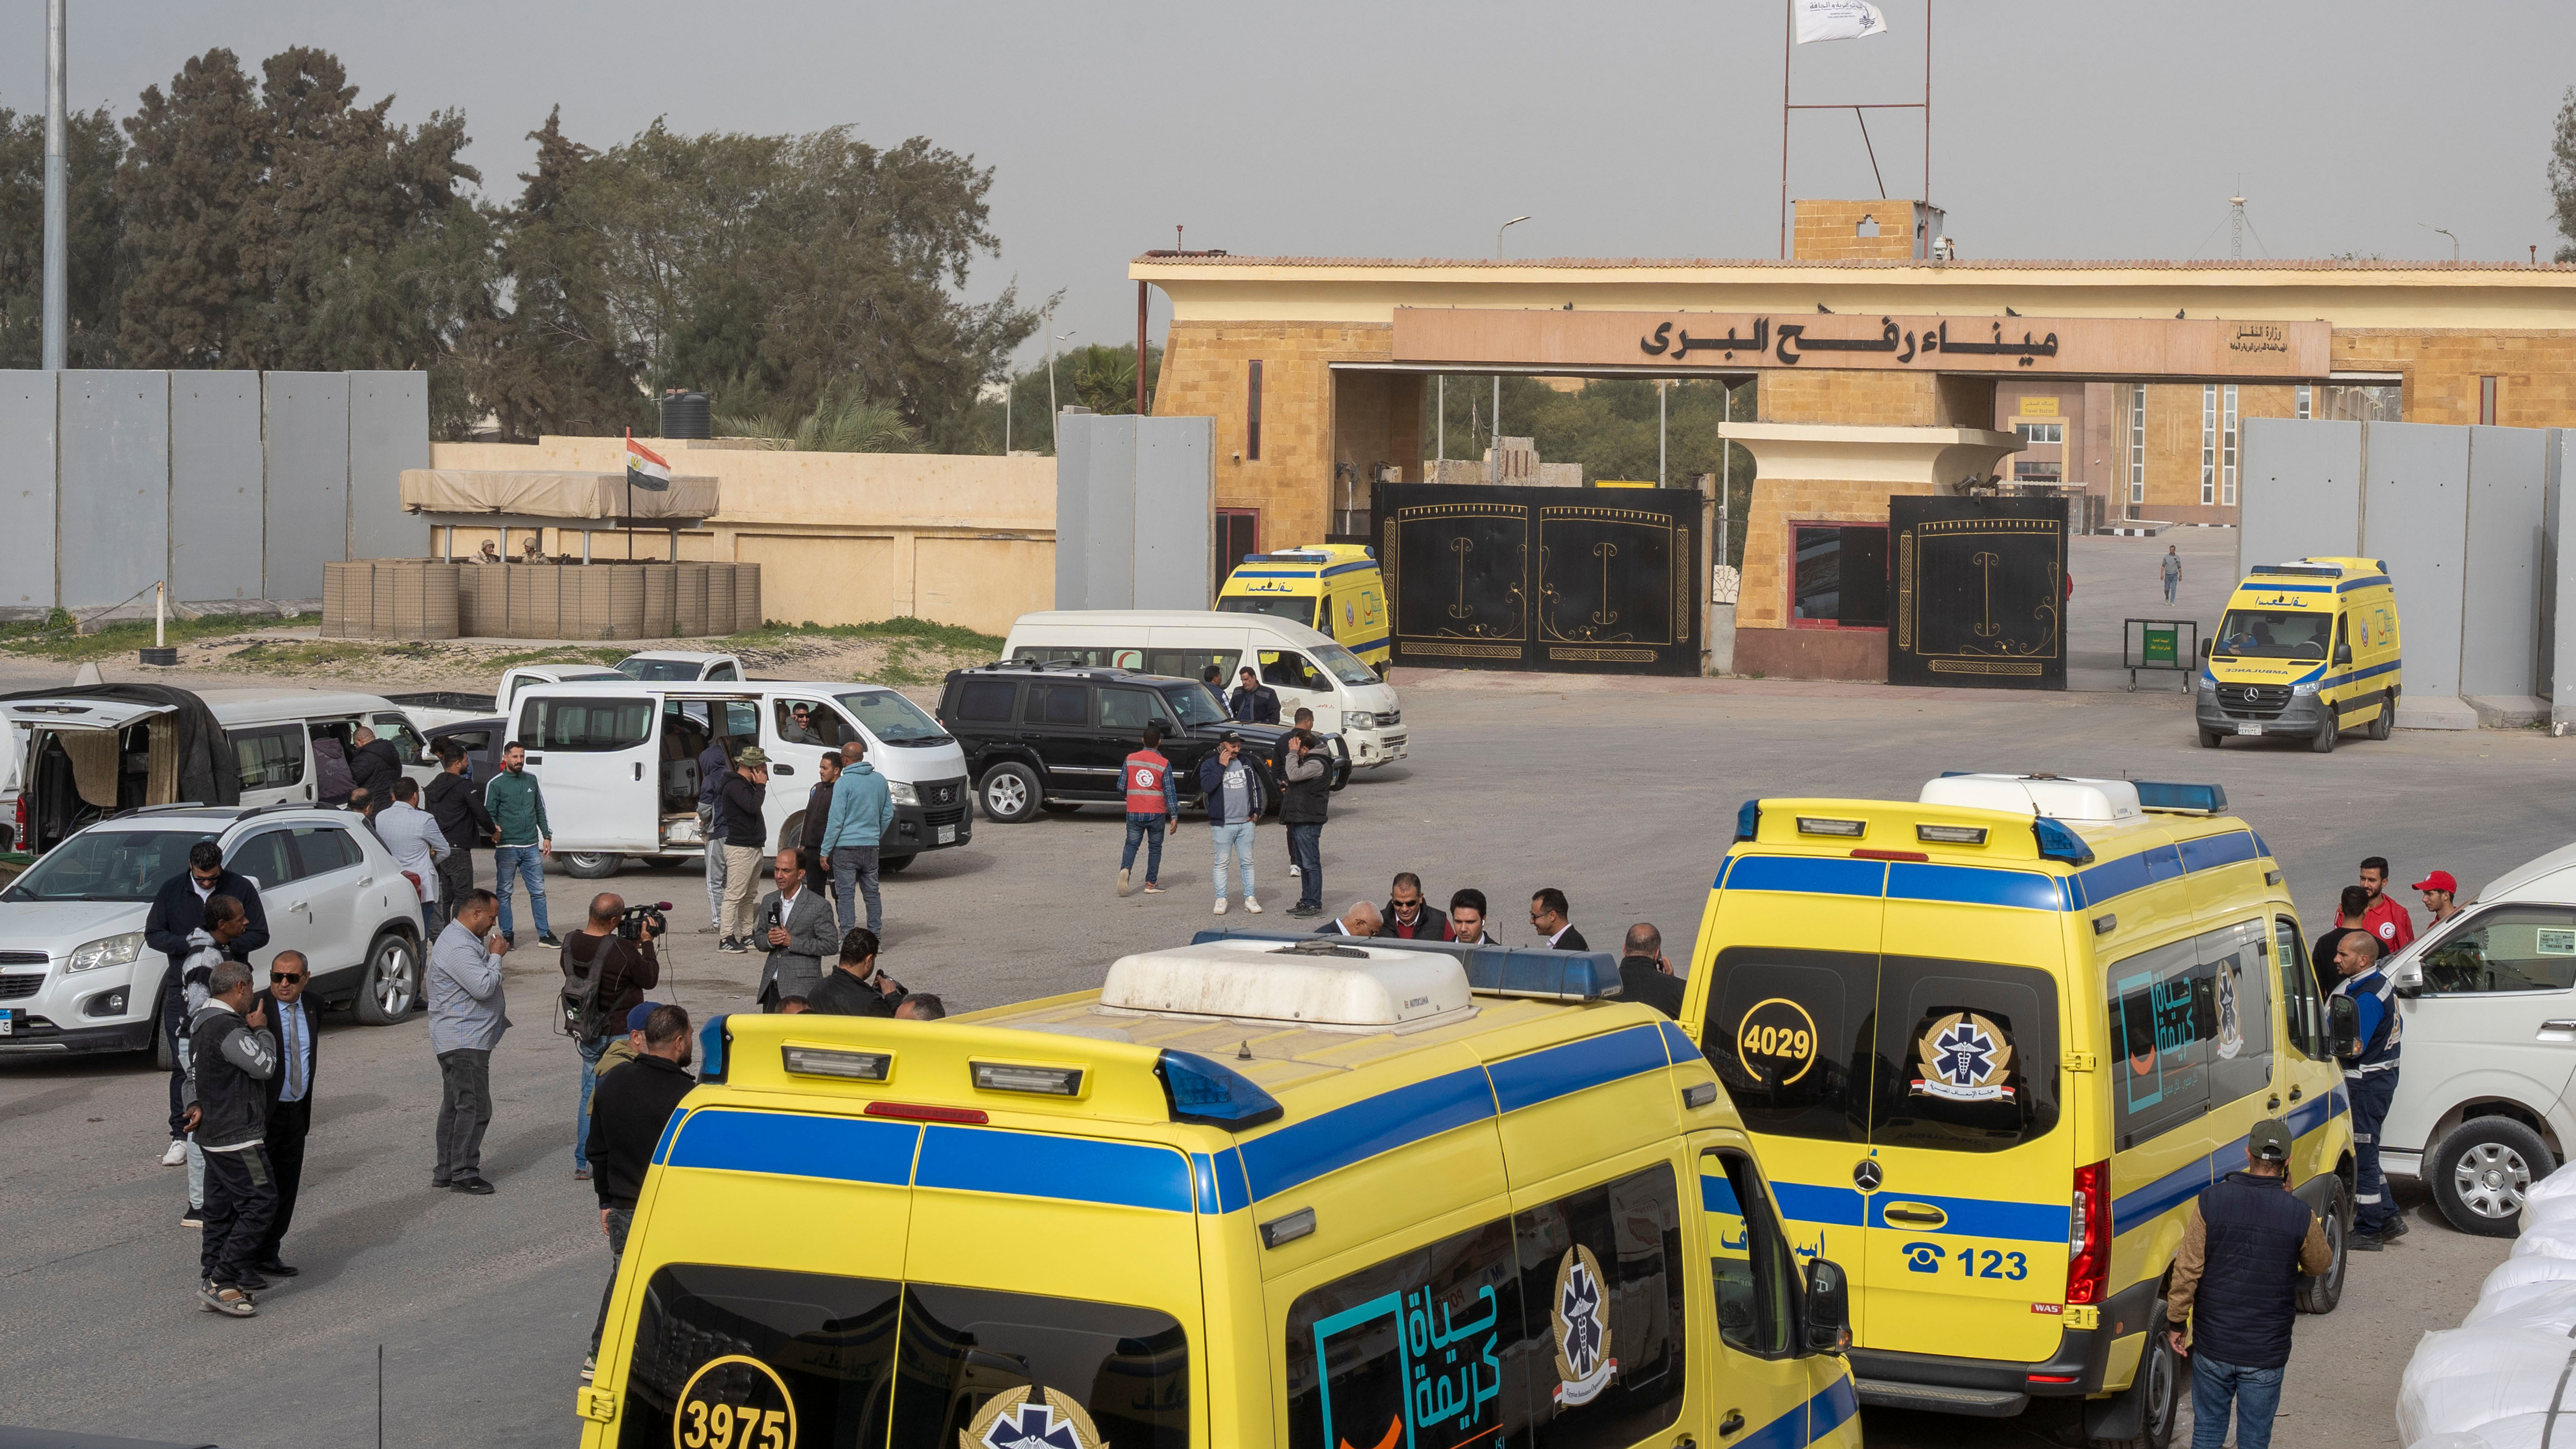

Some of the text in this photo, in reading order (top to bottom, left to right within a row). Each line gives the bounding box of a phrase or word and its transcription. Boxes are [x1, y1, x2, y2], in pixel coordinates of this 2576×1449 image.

[1776, 316, 1915, 364] رفح
[1921, 320, 2058, 367] ميناء
[2237, 325, 2281, 341] وزارة النقل
[2154, 970, 2192, 1020] حياة
[1744, 1024, 1810, 1059] 4029
[2160, 1006, 2195, 1062] كريمة
[1930, 1082, 1950, 1094] المصرية
[1951, 1089, 1977, 1098] الإسعاف
[1957, 1248, 2028, 1281] 123
[1409, 1285, 1497, 1364] حياة
[2035, 1304, 2058, 1313] WAS
[1415, 1331, 1500, 1430] كريمة
[685, 1400, 785, 1449] 3975
